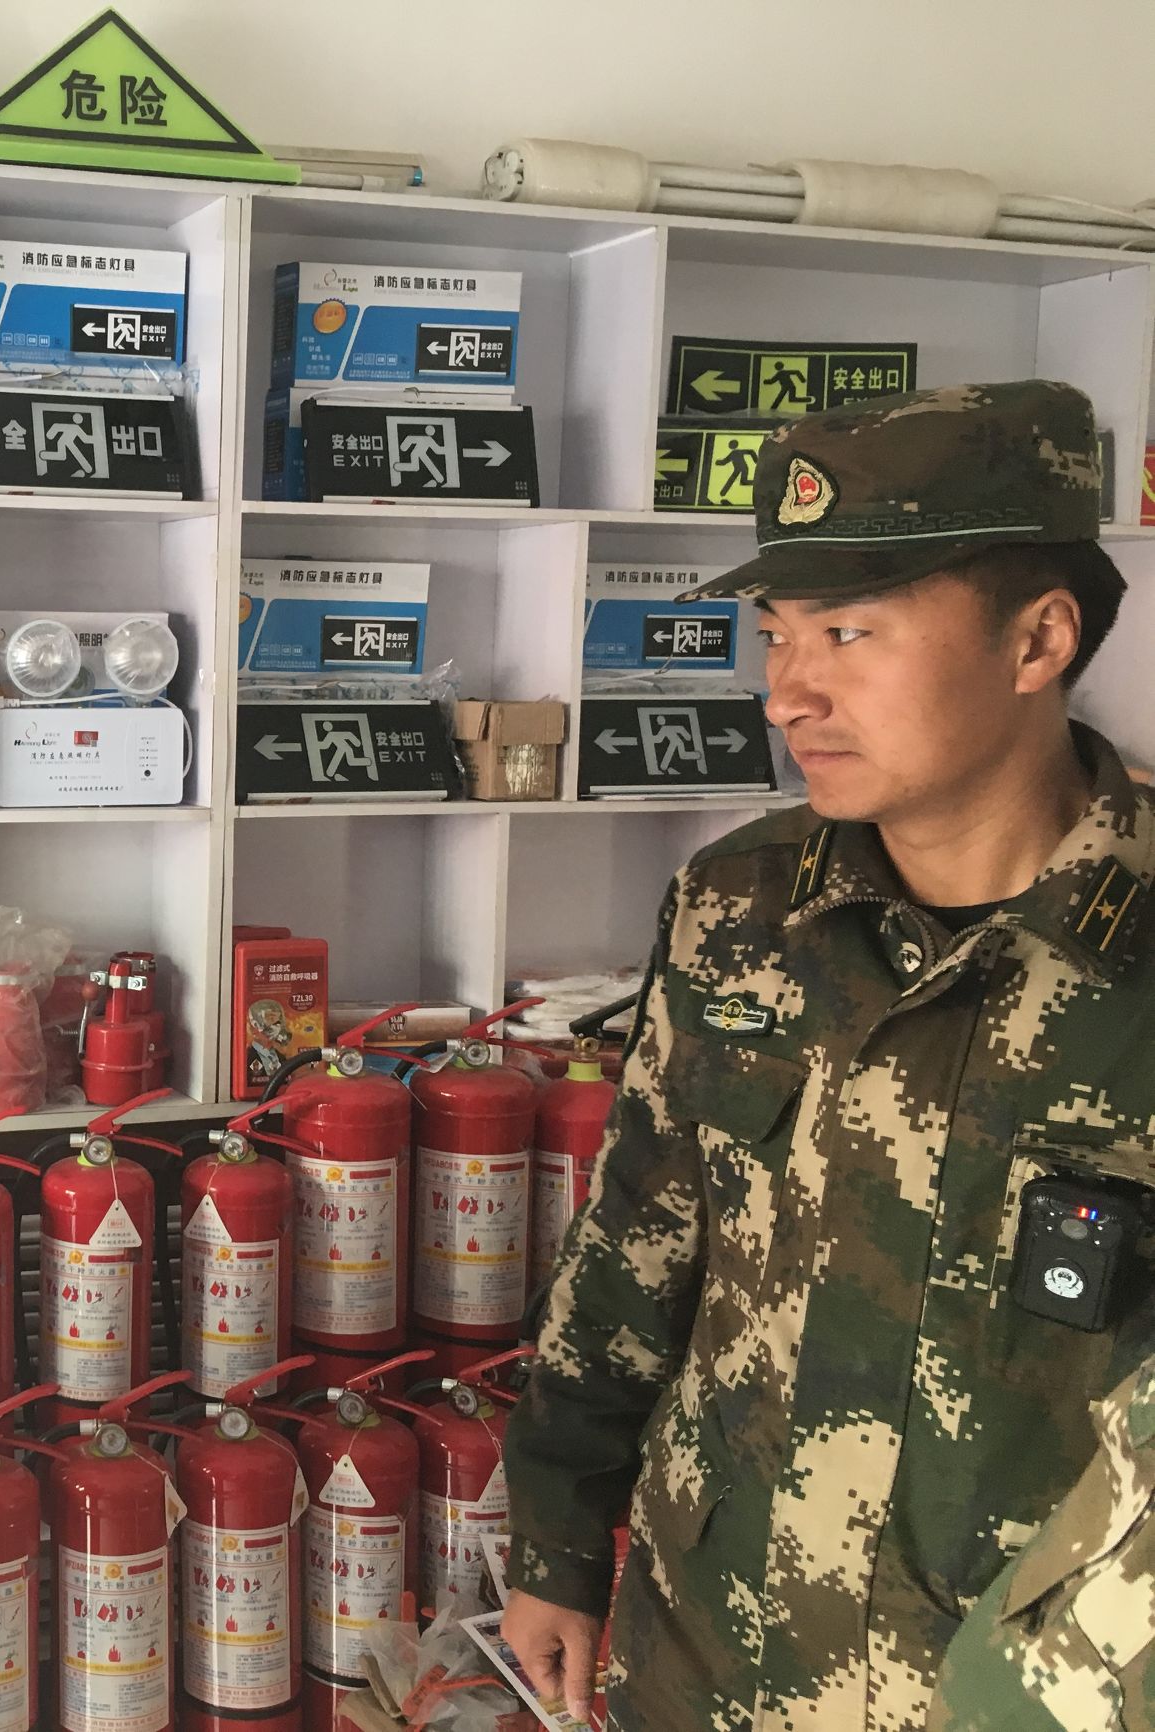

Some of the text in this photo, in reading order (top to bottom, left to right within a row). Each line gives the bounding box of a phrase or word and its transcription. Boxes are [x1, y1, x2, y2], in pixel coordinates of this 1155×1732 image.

[60, 69, 168, 127] 危险
[21, 252, 136, 272] 消防应急标志灯具
[373, 275, 477, 292] 消防应急标志灯具
[142, 325, 167, 334] 安全出口
[142, 335, 166, 343] EXIT
[480, 342, 504, 351] 安全出口
[833, 366, 900, 390] 安全出口
[111, 425, 163, 457] 出口
[331, 433, 384, 451] 安全出口
[333, 455, 385, 468] EXIT
[654, 485, 684, 498] 出口
[279, 569, 383, 585] 消防应急标志灯具
[605, 570, 699, 584] 消防应急标志灯具
[386, 632, 409, 641] 安全出口
[375, 731, 425, 747] 安全出口
[378, 751, 427, 764] EXIT
[292, 994, 314, 1002] TZL30
